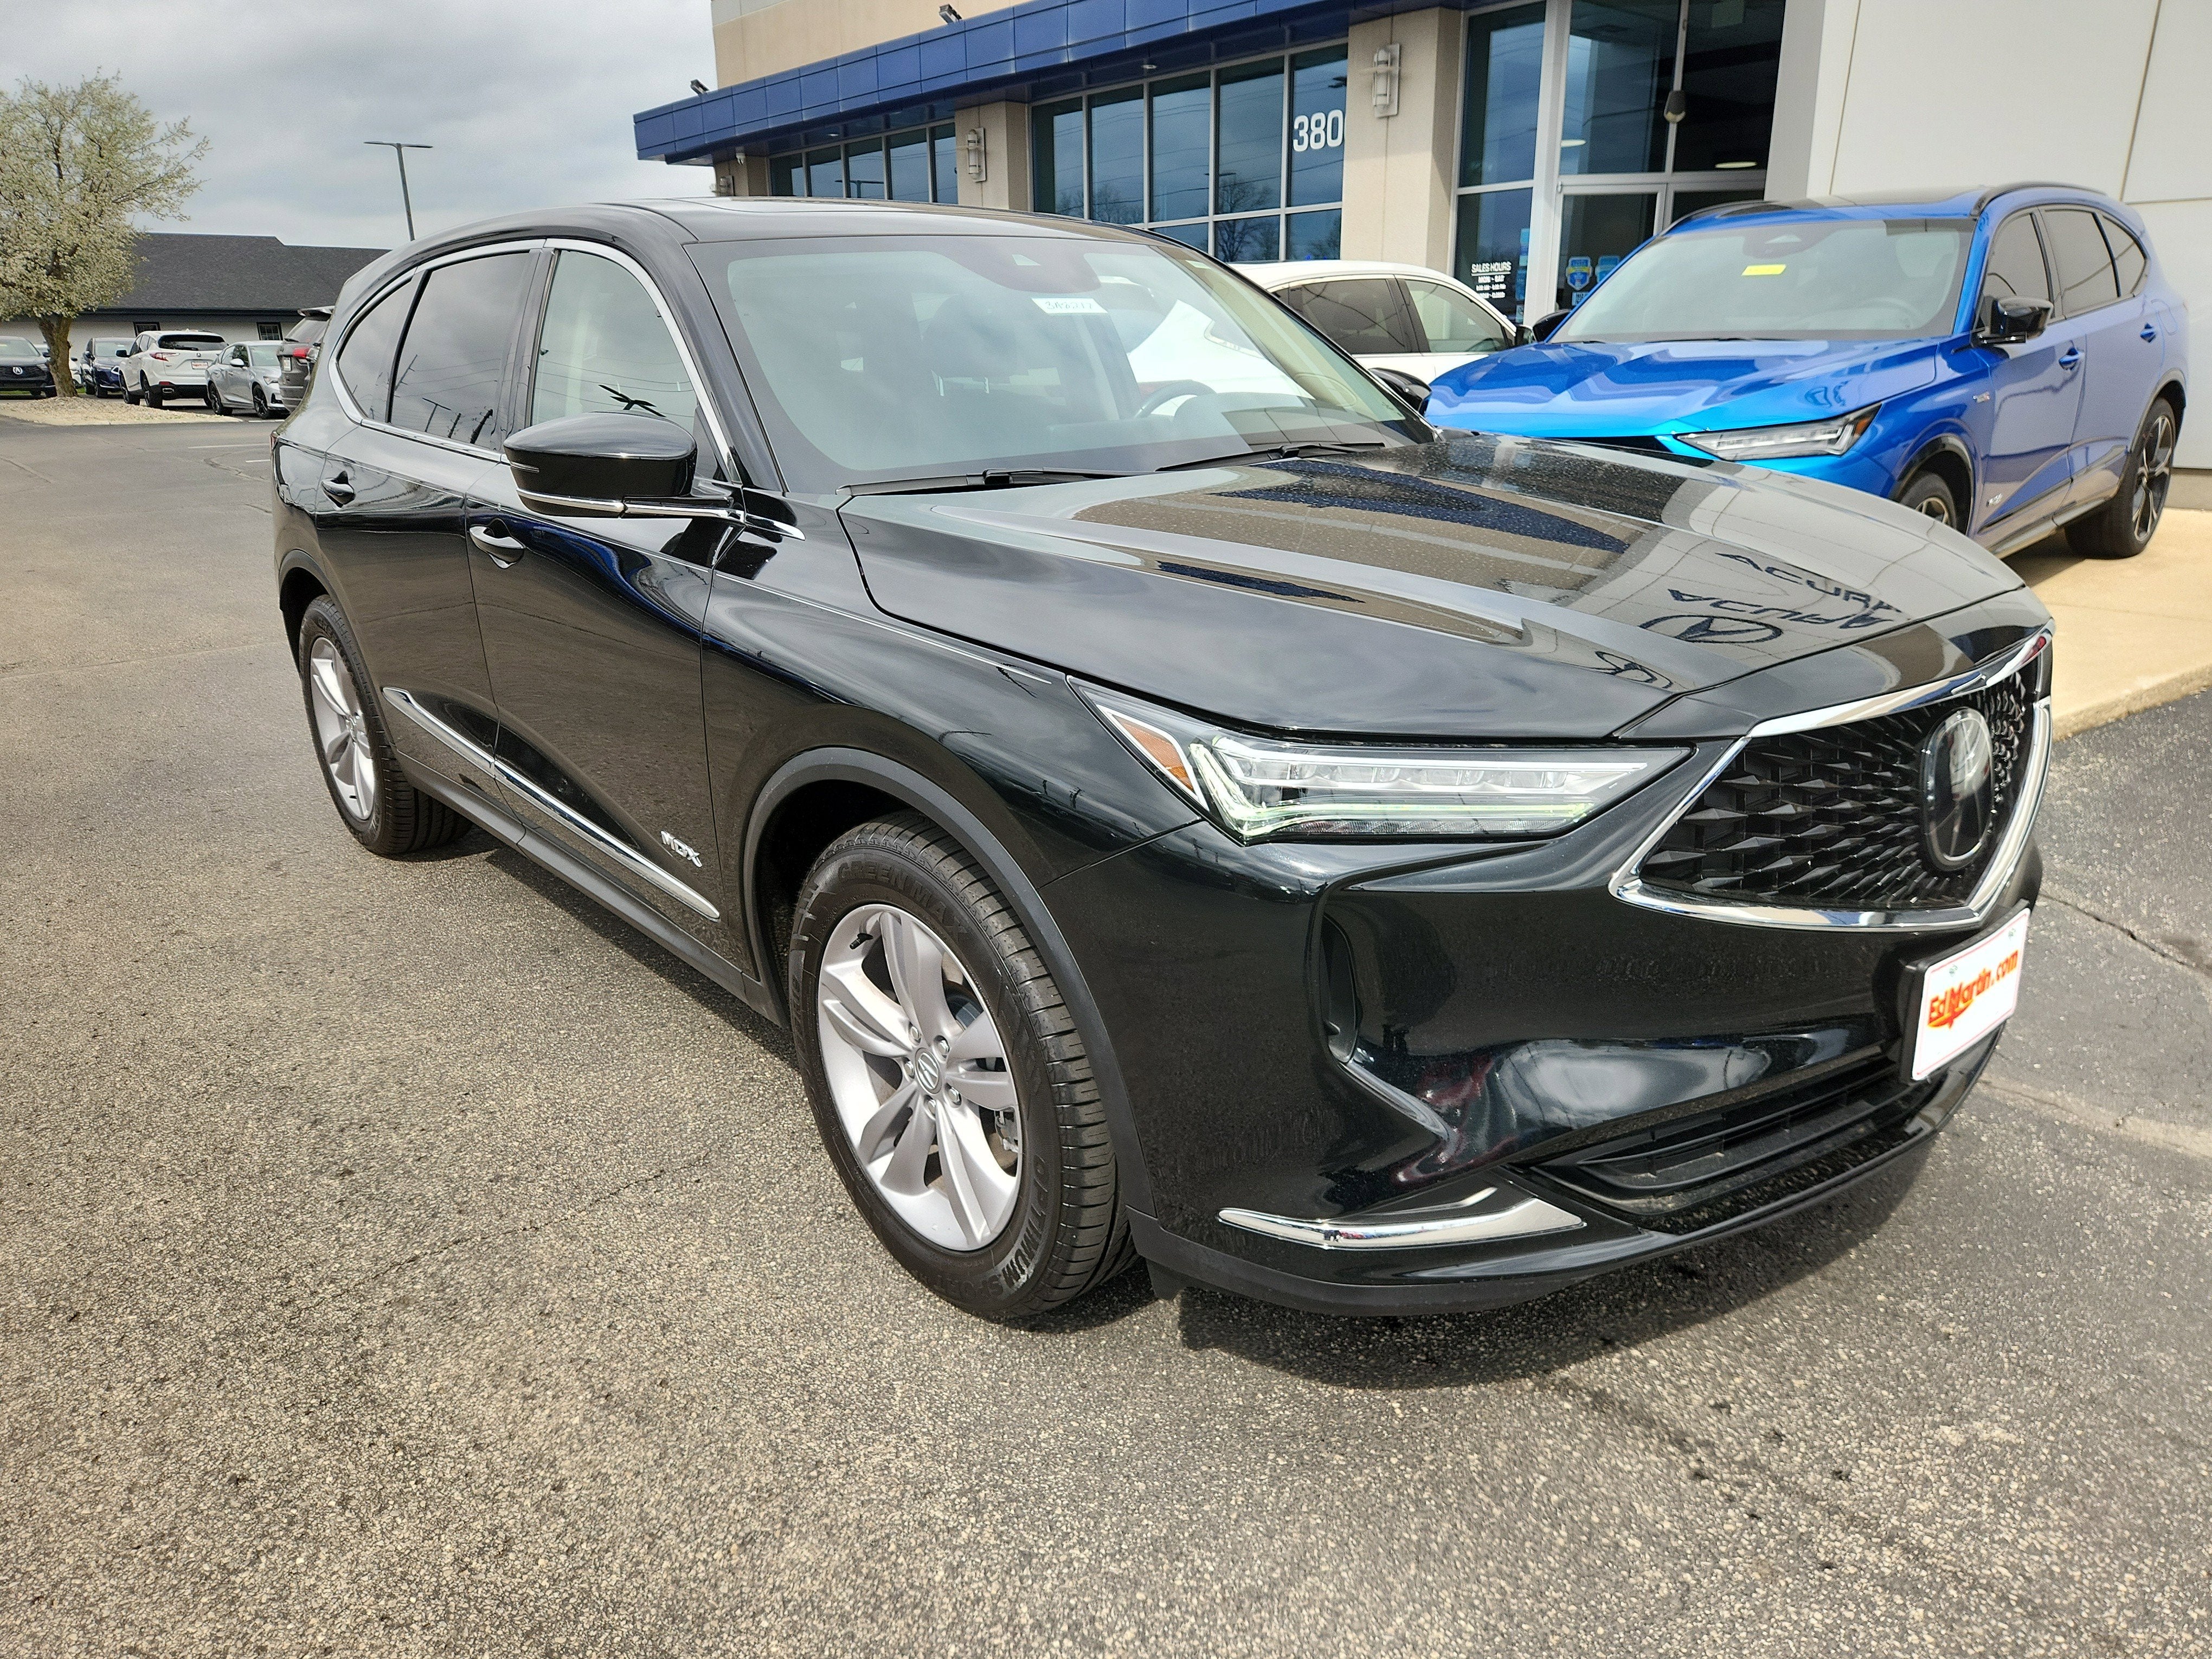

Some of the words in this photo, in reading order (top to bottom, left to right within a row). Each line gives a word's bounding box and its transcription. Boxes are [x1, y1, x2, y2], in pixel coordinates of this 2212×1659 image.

[1471, 263, 1490, 273] SALES
[1490, 261, 1512, 272] HOURS
[1714, 552, 1902, 614] ACURA
[661, 830, 703, 867] MDX
[1927, 949, 2018, 1028] EdMartin.com
